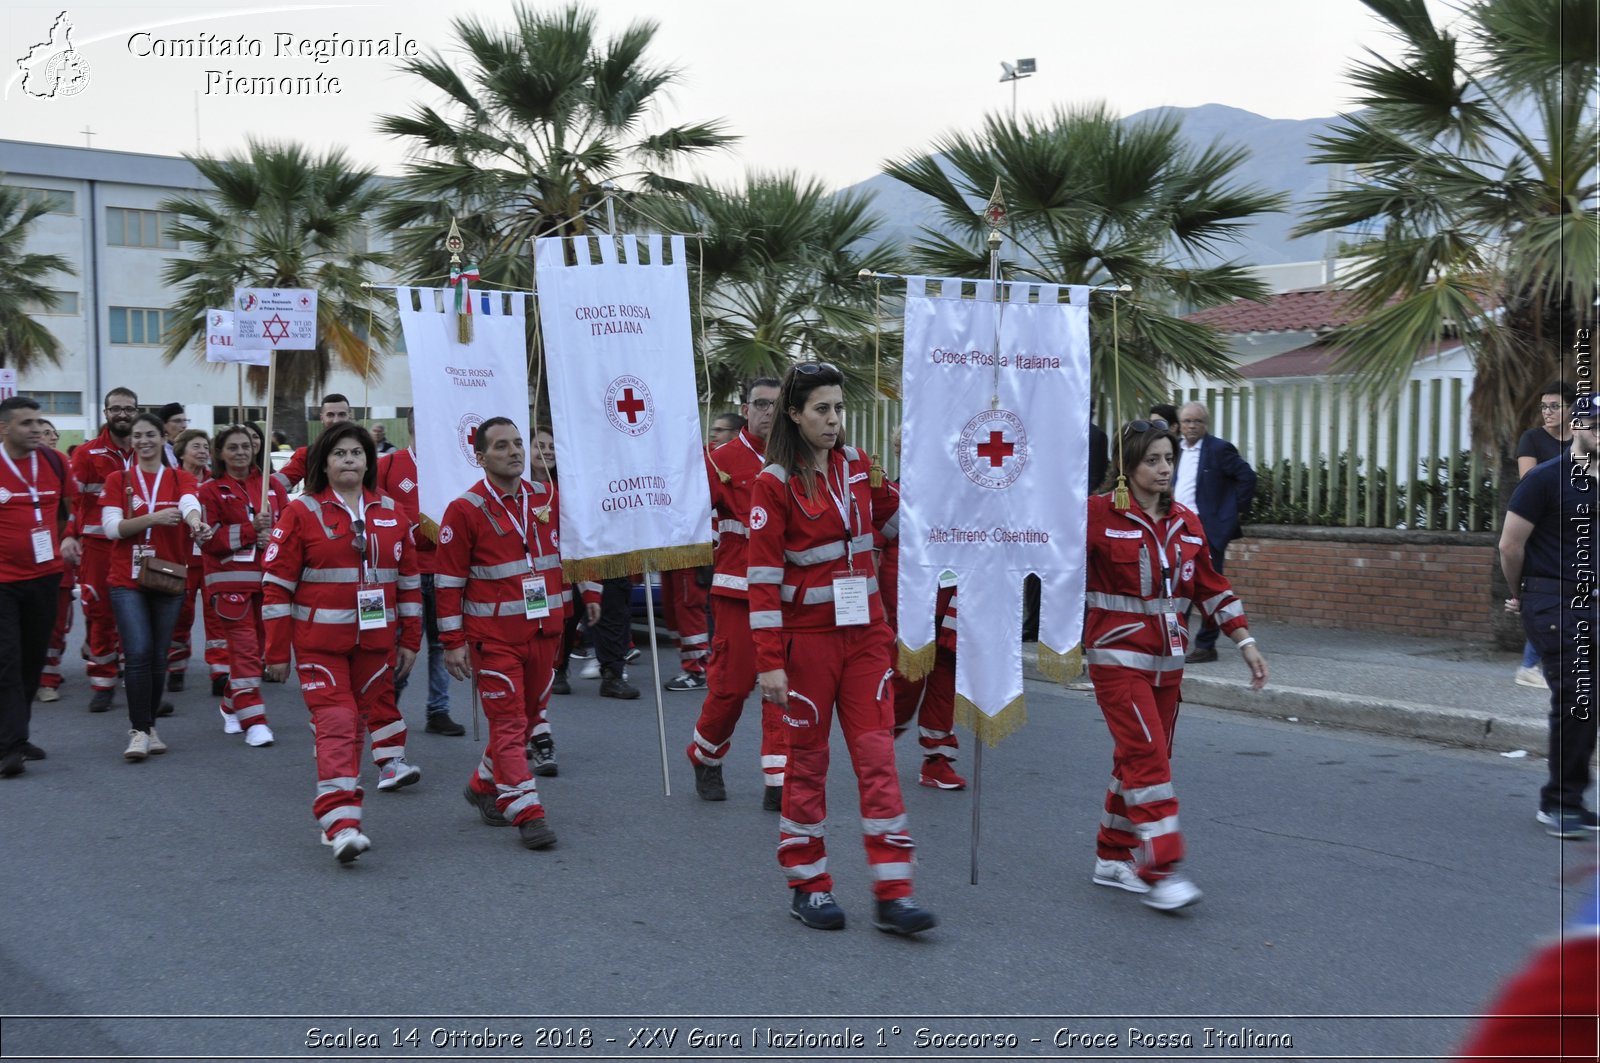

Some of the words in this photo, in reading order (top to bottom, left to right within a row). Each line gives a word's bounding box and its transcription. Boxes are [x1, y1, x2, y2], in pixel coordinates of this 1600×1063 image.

[575, 305, 617, 321] CROCE
[619, 304, 651, 319] ROSSA
[591, 321, 643, 336] ITALIANA
[932, 349, 967, 364] Croce
[971, 351, 1008, 367] Rosa
[1016, 355, 1060, 370] Italiana
[445, 366, 467, 377] CROCE
[469, 369, 494, 377] ROSSA
[453, 377, 487, 387] ITALIANA
[610, 386, 617, 394] DI
[615, 378, 639, 387] GINEVRA
[968, 421, 977, 431] DI
[978, 412, 1016, 424] GINEVRA
[960, 432, 994, 486] CONVENZIONE
[608, 476, 666, 494] COMITATO
[601, 494, 644, 512] GIOIA
[645, 492, 672, 506] TAURO
[928, 528, 948, 543] Alto
[950, 528, 987, 542] Tirreno
[993, 527, 1049, 544] Cosentino
